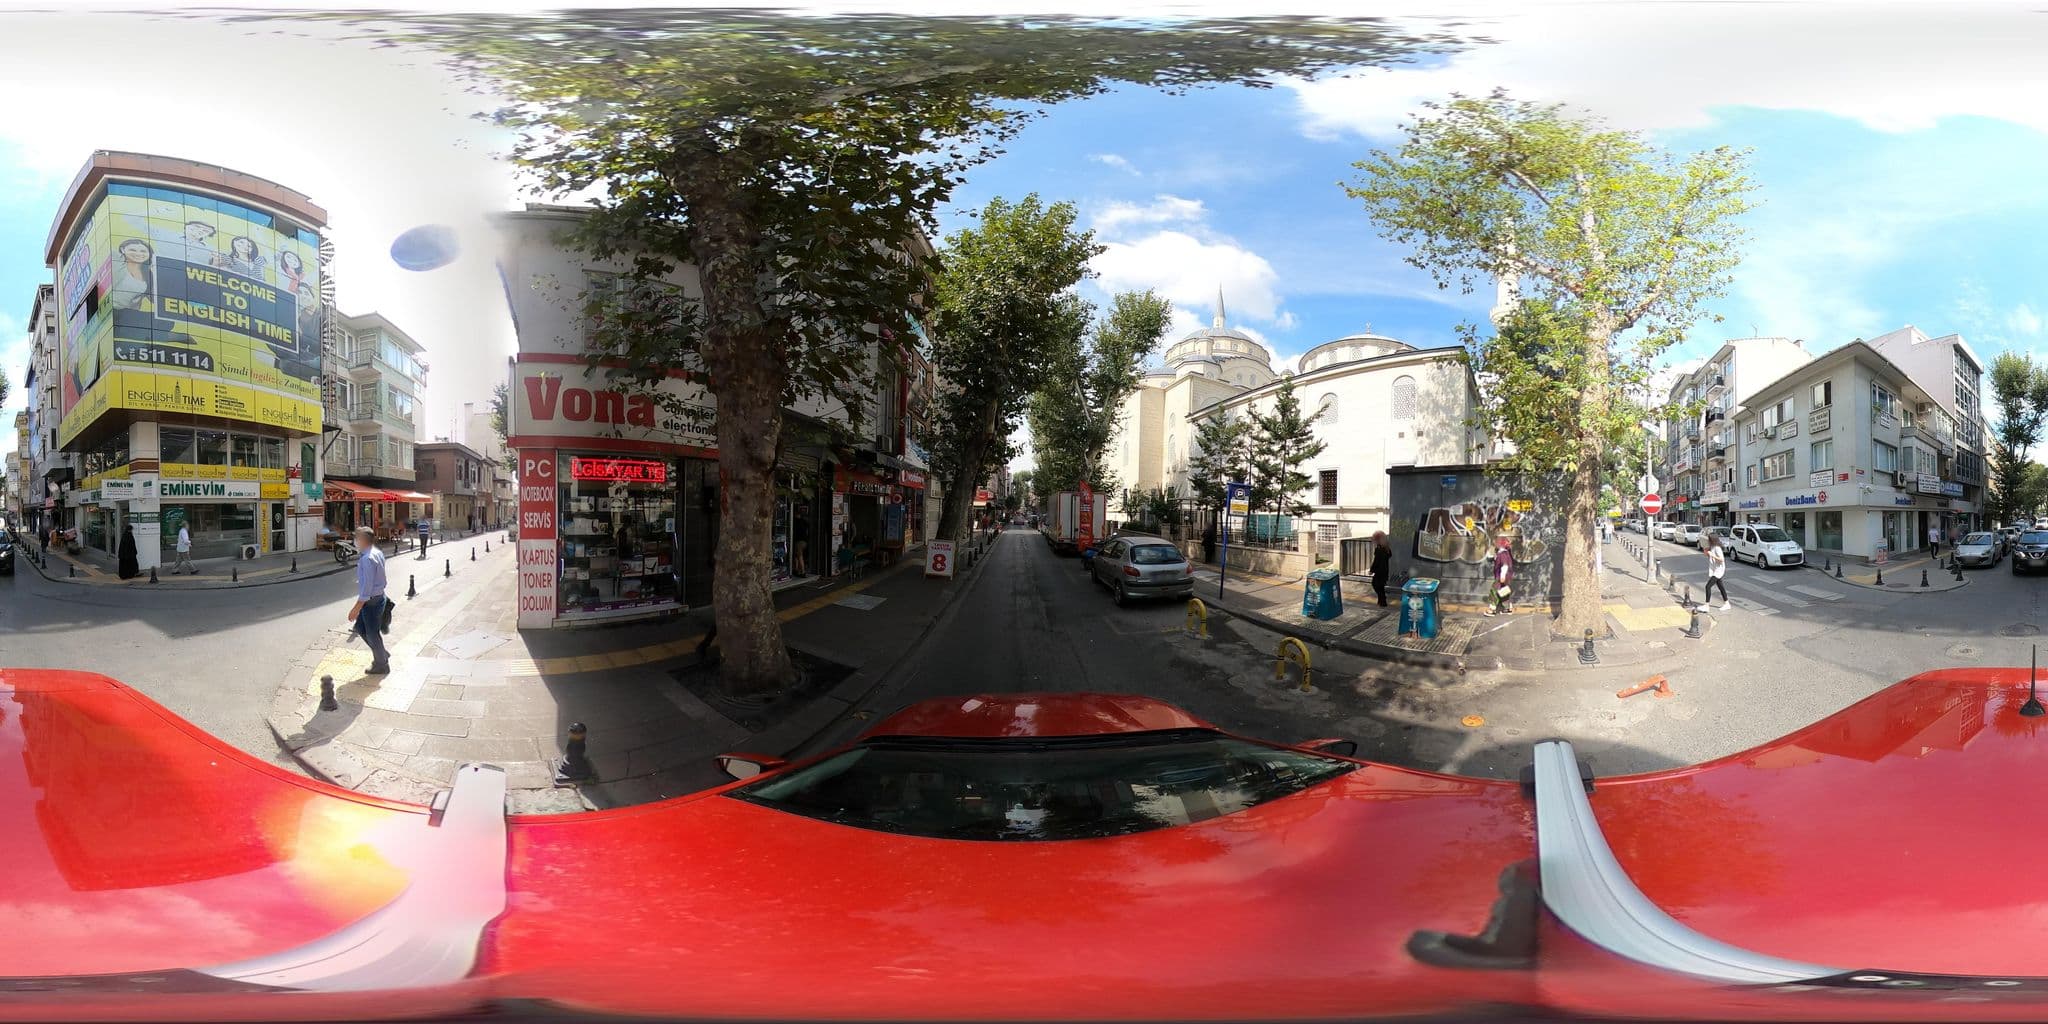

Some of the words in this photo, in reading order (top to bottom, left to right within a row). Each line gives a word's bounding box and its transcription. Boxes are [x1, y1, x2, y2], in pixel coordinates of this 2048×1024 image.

[186, 266, 276, 303] WELCOME
[222, 292, 248, 310] TO
[165, 297, 250, 329] ENGLISH
[254, 319, 292, 344] TIME
[139, 348, 165, 363] 511
[172, 351, 187, 366] 11
[192, 355, 209, 369] 14
[127, 390, 174, 402] ENGLISH
[182, 395, 206, 406] TIME
[524, 376, 657, 428] Vona
[262, 407, 293, 422] ENGLISH
[298, 415, 313, 426] TIME
[525, 458, 552, 478] PC
[160, 480, 225, 496] EMİNEVİM
[521, 486, 555, 502] NOTEBOOK
[1785, 494, 1817, 506] DenizBank
[524, 510, 551, 529] SERVİS
[932, 553, 947, 572] 8
[523, 572, 553, 589] TONER
[522, 595, 553, 612] DOLUM
